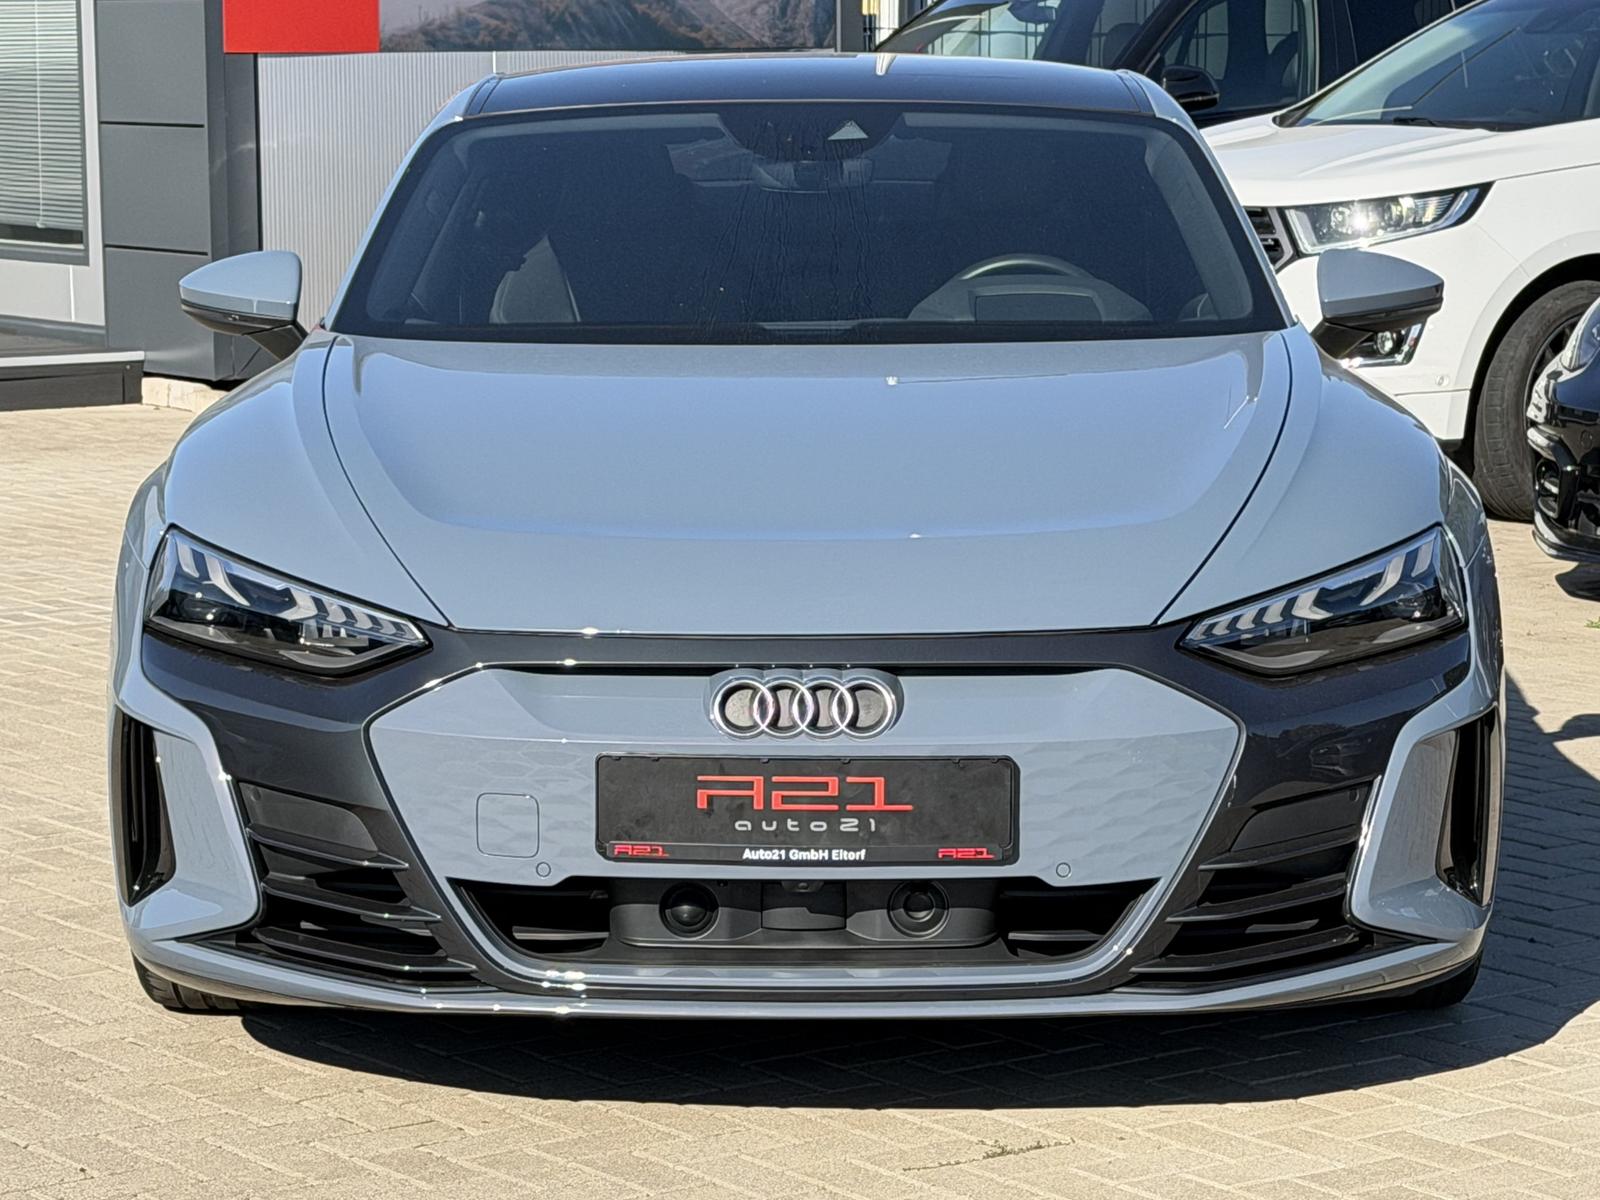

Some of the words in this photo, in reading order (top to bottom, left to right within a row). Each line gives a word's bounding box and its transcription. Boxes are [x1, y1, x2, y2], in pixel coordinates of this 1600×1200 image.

[697, 775, 914, 812] A21
[734, 818, 876, 832] auto21
[614, 844, 670, 857] A21
[742, 848, 786, 860] Auto21
[789, 849, 829, 860] GmbH
[938, 847, 995, 859] A21
